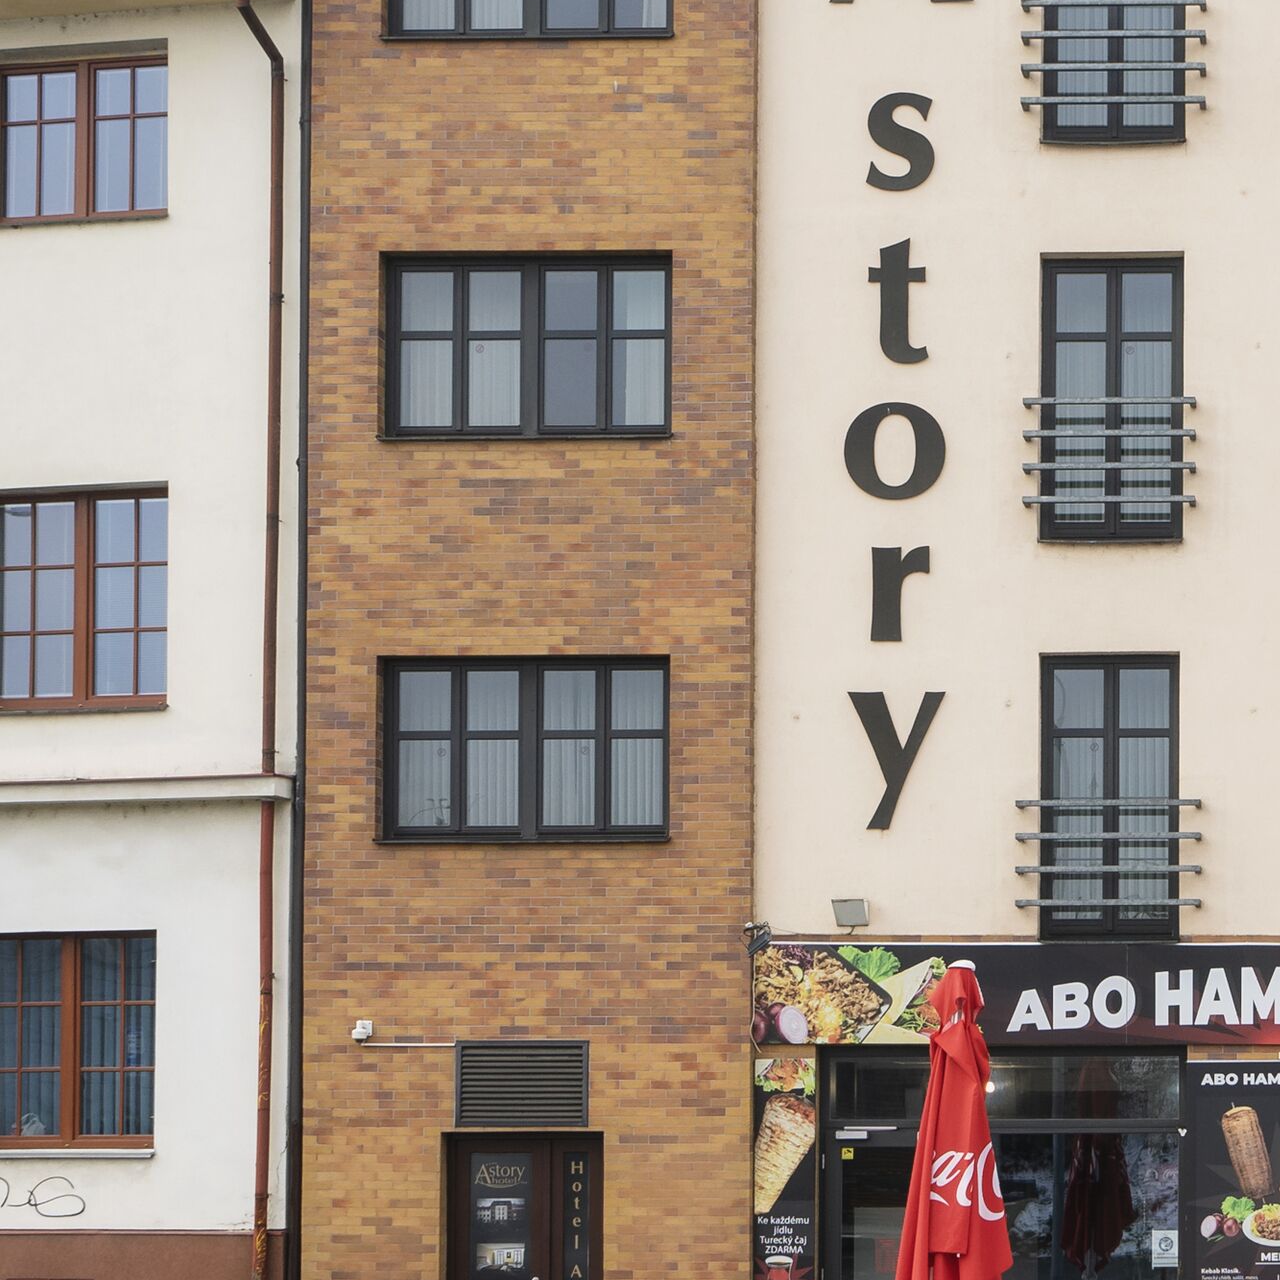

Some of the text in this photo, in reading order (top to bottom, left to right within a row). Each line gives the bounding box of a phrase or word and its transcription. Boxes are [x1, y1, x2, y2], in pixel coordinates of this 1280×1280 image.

[1007, 976, 1136, 1033] ABO
[1201, 1073, 1238, 1086] ABO
[474, 1163, 526, 1184] Astory
[570, 1161, 583, 1249] Hotel
[757, 1215, 810, 1225] Ke každému
[773, 1226, 793, 1236] jídlu
[760, 1235, 807, 1246] Turecký čaj
[765, 1245, 804, 1254] ZDARMA
